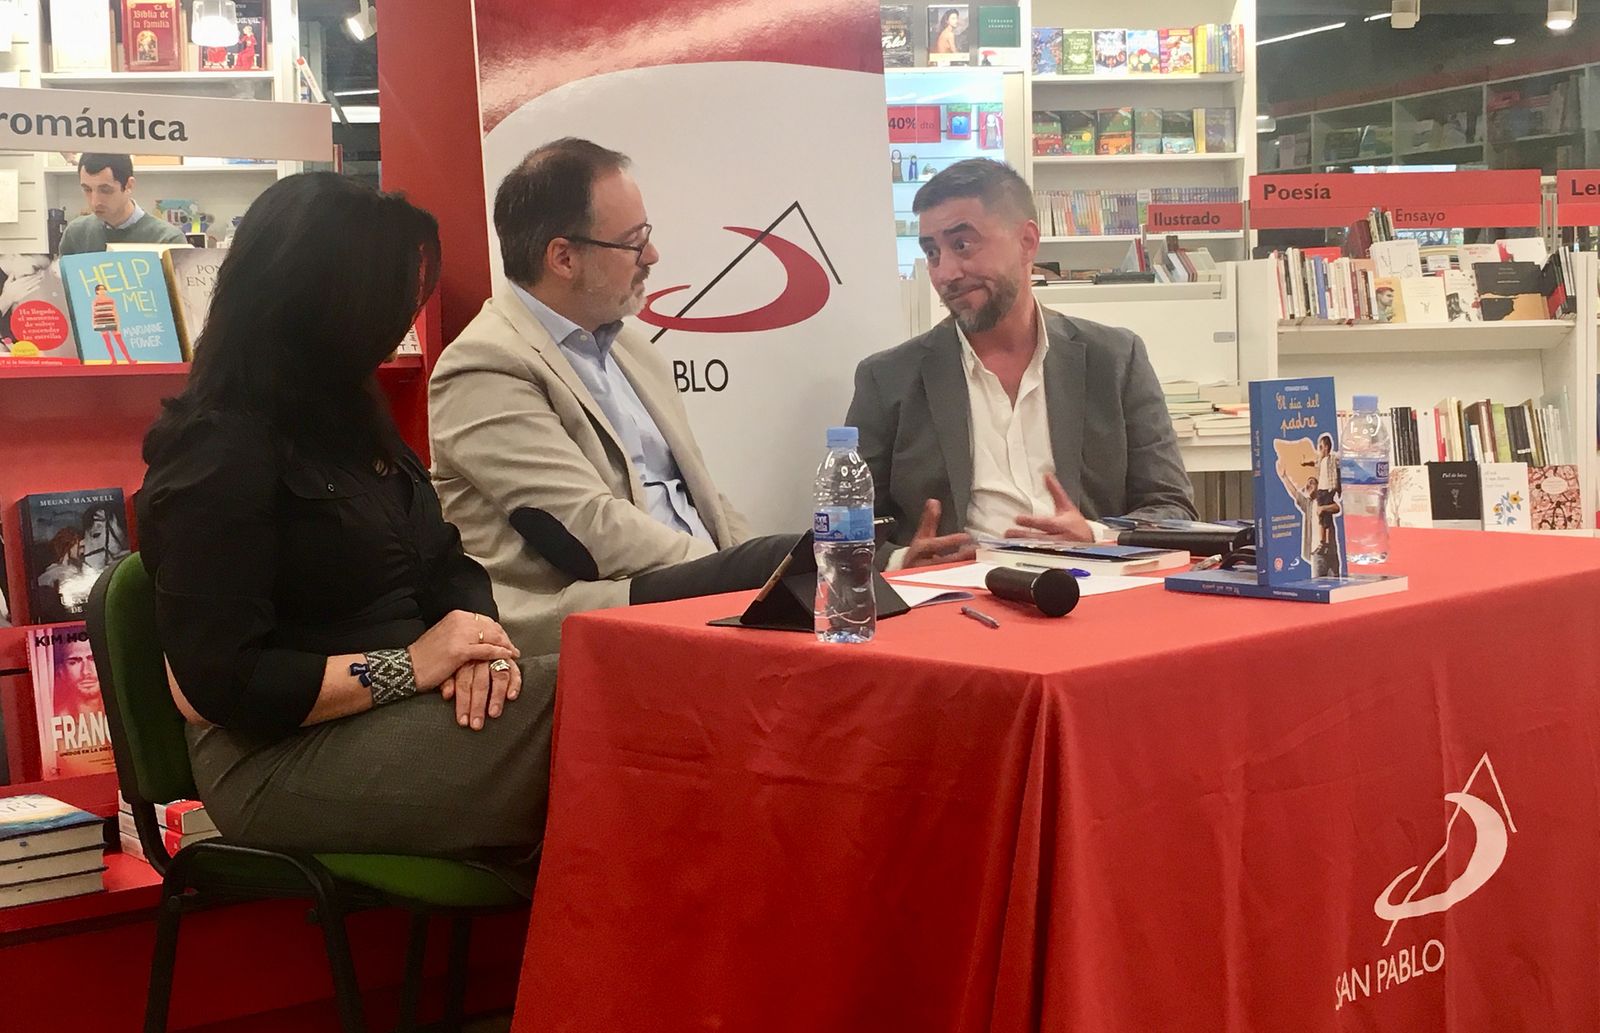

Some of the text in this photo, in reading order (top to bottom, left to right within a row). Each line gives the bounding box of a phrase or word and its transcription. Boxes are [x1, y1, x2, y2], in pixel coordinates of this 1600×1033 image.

[1263, 183, 1331, 201] Poesía
[1571, 178, 1600, 196] Le
[1154, 211, 1221, 226] Ilustrado
[1395, 208, 1446, 226] Ensayo
[79, 257, 151, 298] HELP
[121, 290, 158, 313] ME!
[1280, 411, 1318, 438] padre
[73, 494, 114, 504] MAXWELL
[35, 635, 63, 647] KIM
[1335, 939, 1445, 1011] SAN PABLO
